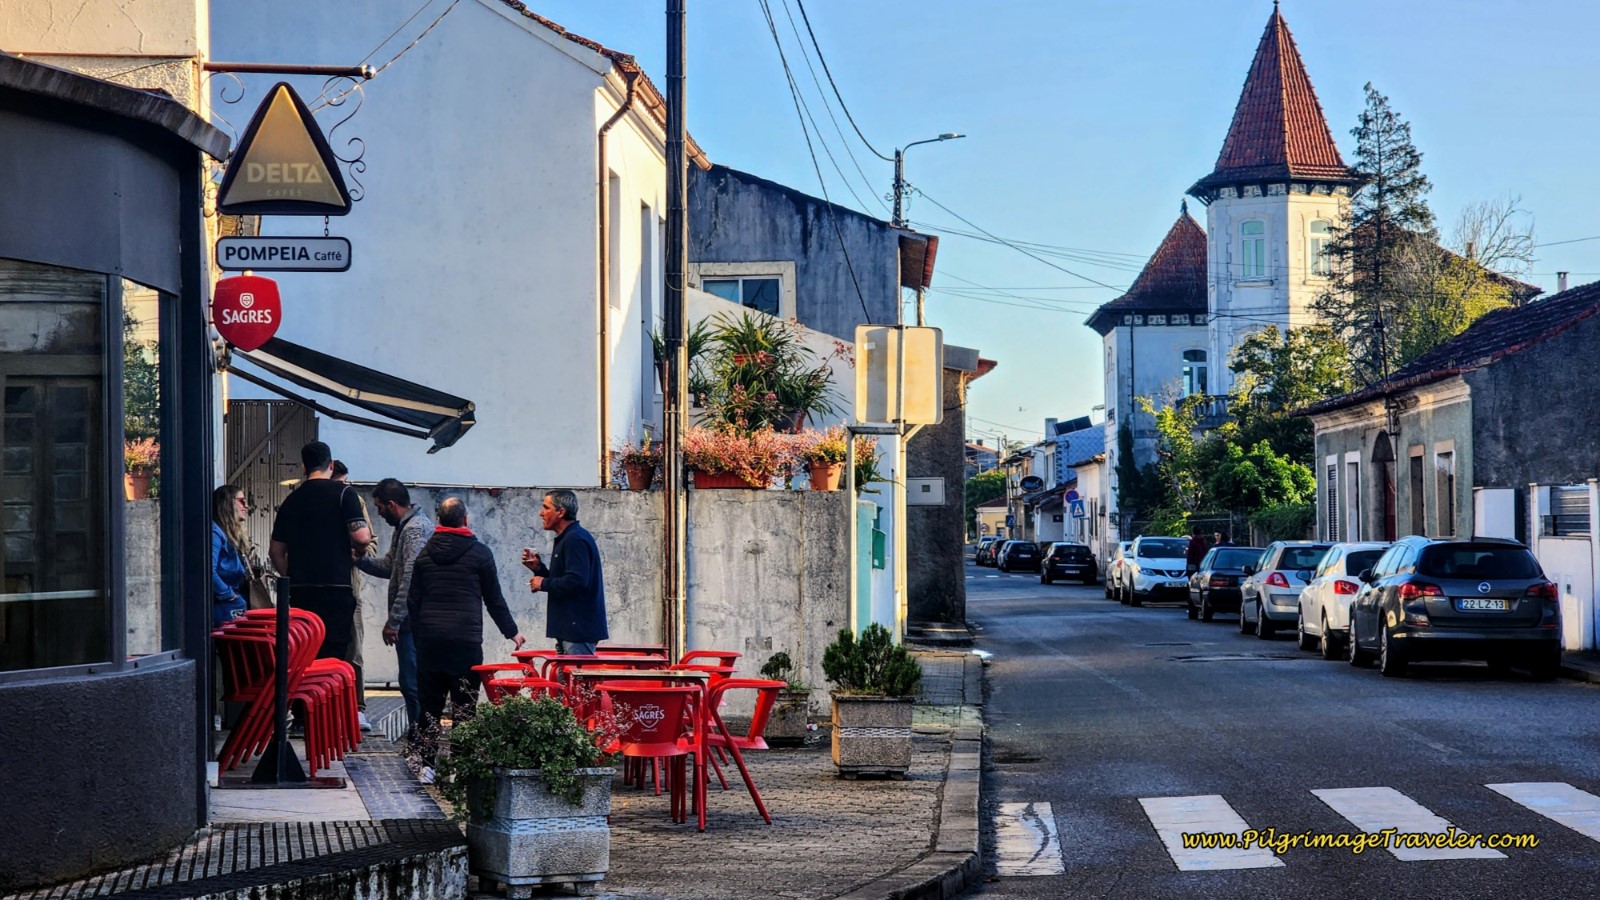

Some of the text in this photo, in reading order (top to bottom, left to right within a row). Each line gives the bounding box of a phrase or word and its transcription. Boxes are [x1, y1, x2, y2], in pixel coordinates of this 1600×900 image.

[247, 163, 322, 183] DELTA
[225, 246, 342, 261] POMPEIA Caffé
[222, 309, 272, 325] SAGRES
[634, 709, 665, 720] SAGRES
